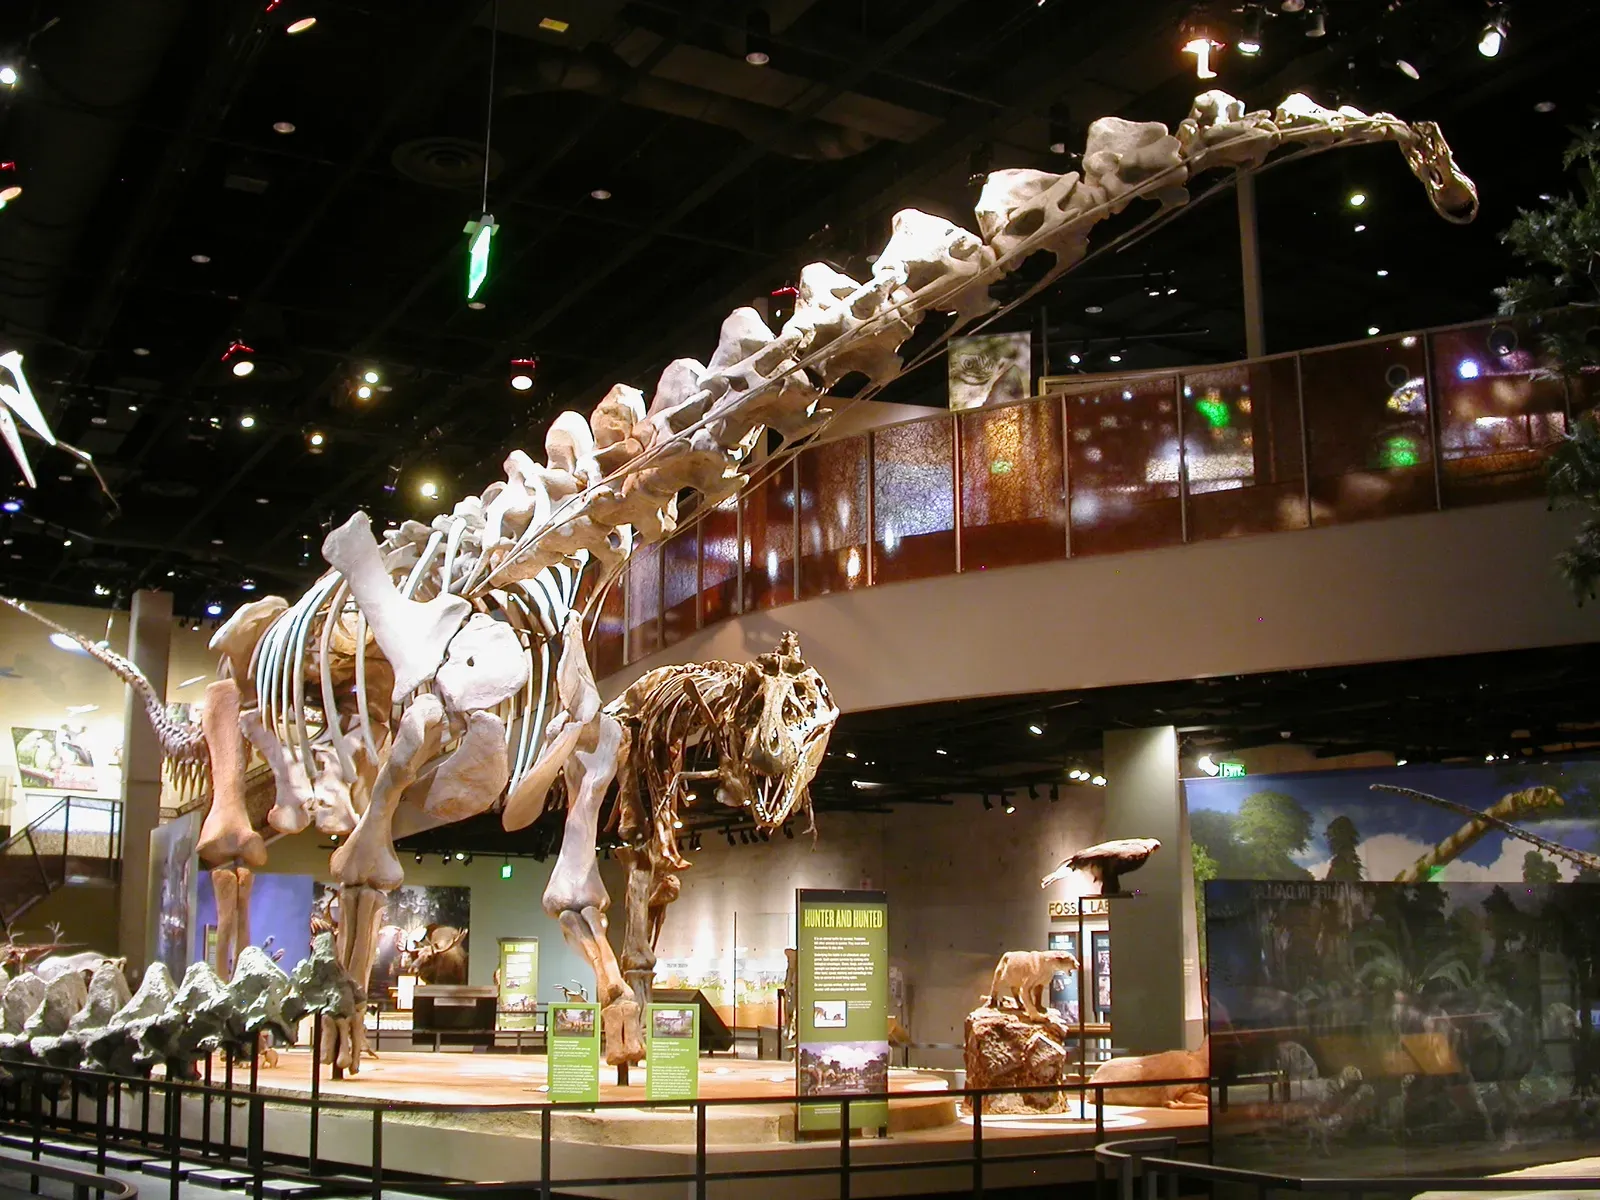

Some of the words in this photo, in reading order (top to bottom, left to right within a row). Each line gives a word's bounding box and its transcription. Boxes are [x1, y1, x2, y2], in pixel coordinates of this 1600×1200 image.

[804, 909, 834, 928] HUNTER
[836, 909, 852, 928] AND
[853, 909, 883, 929] HUNTED
